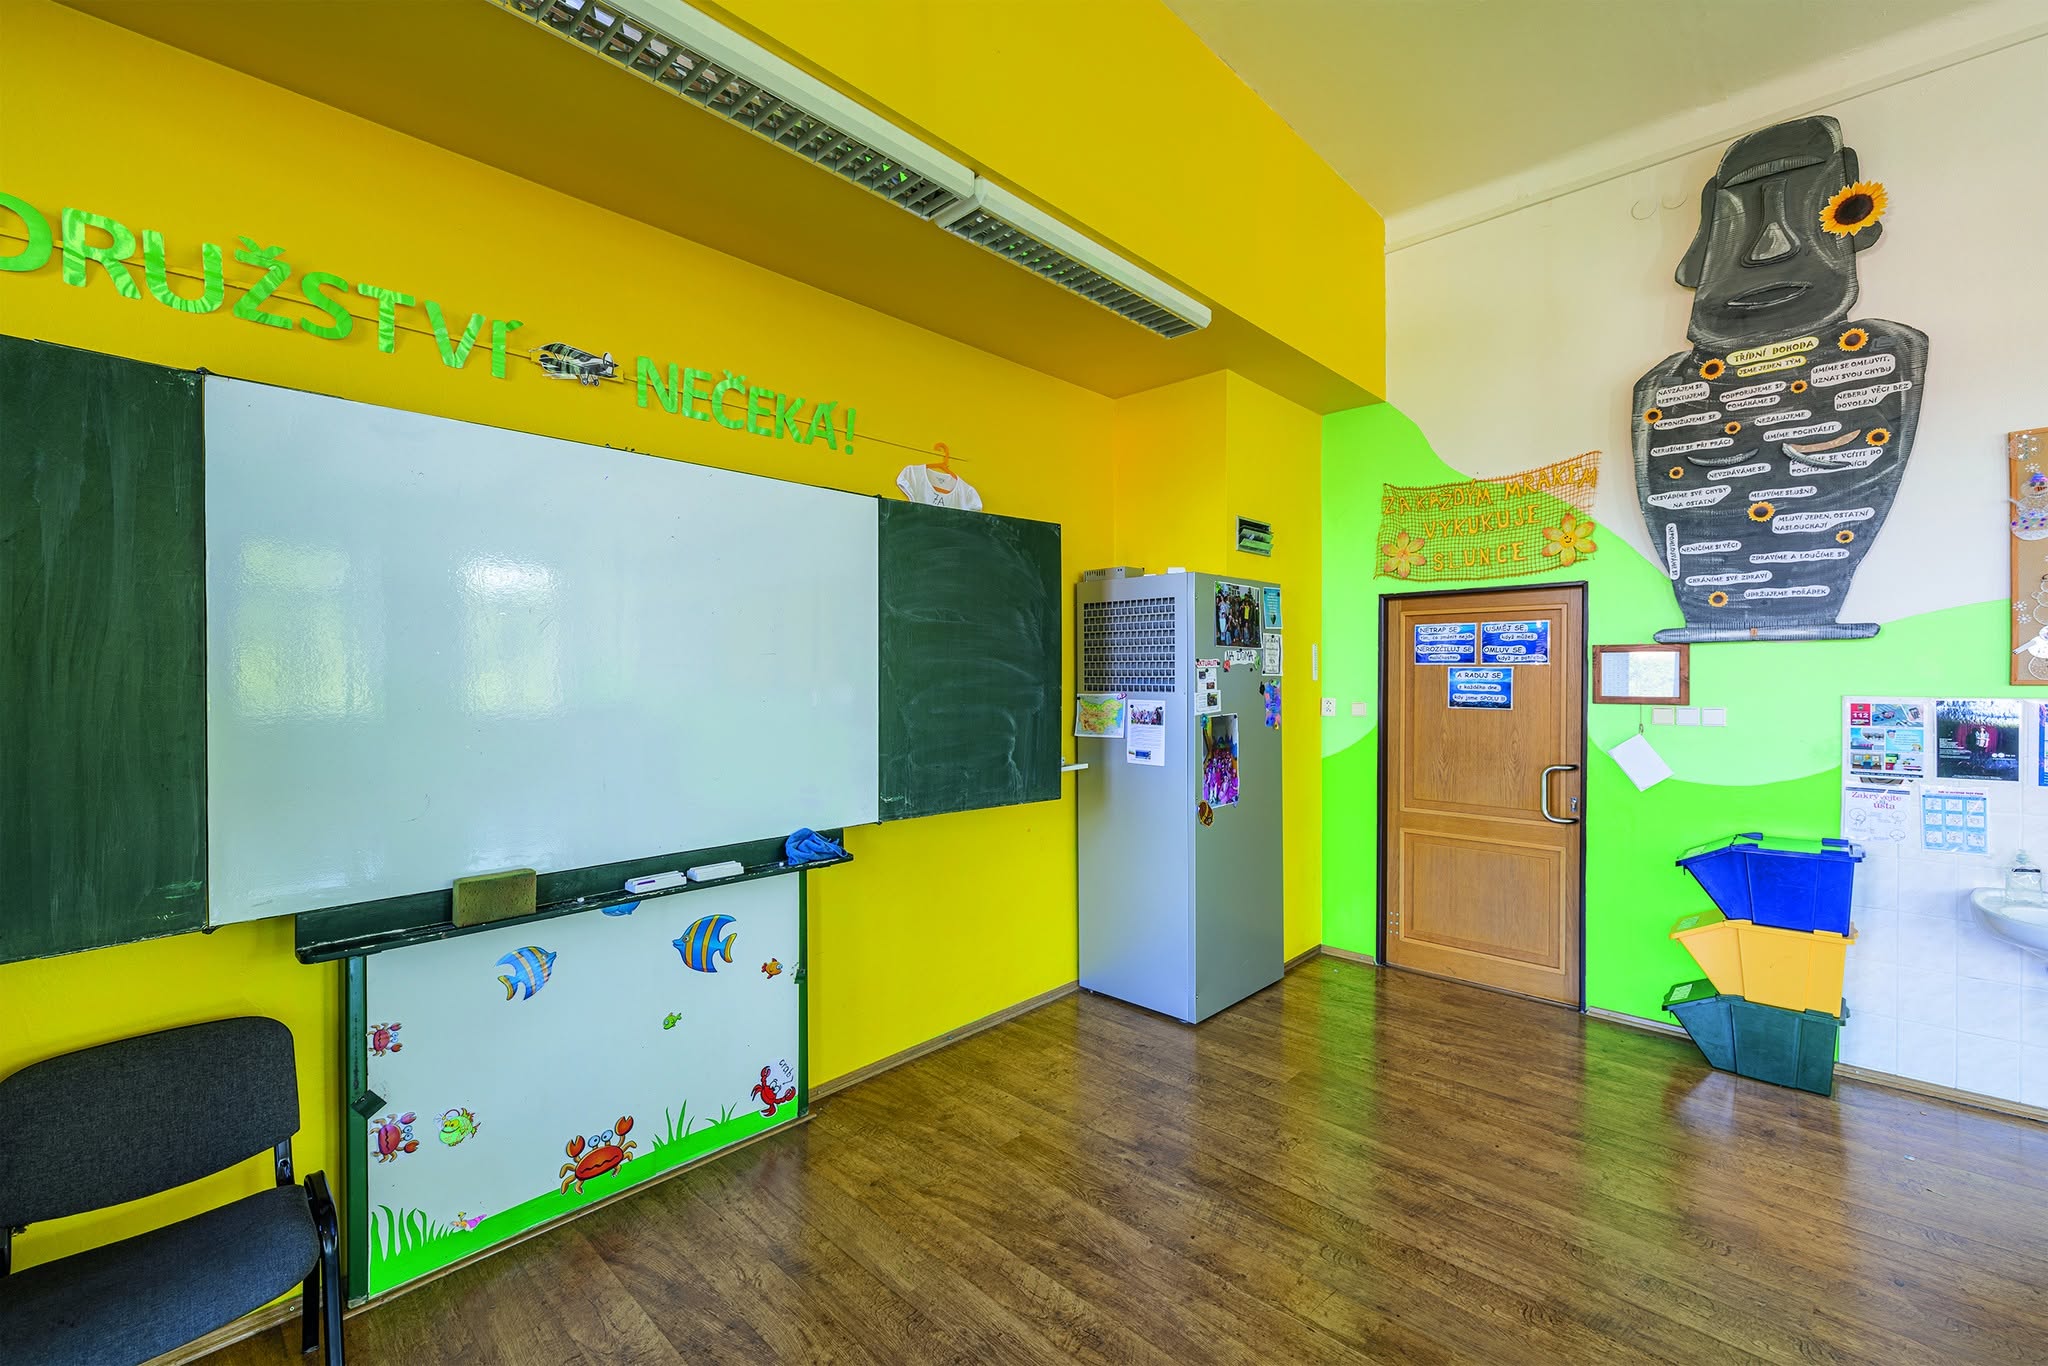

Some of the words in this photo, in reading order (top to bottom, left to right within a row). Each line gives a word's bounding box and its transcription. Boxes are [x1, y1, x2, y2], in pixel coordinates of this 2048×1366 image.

[1734, 349, 1767, 363] TŘÍDNÍ
[1772, 340, 1814, 356] DOHODA
[1738, 365, 1758, 376] JSME
[1758, 362, 1782, 373] JEDEN
[1784, 356, 1801, 367] TÝM
[1812, 363, 1839, 374] UMÍME
[1840, 361, 1850, 370] SE
[1812, 373, 1840, 385] UZNAT
[1841, 370, 1863, 381] SVOU
[1864, 366, 1892, 378] CHYBU
[1695, 382, 1703, 390] SE
[1721, 385, 1772, 400] PODPORUJEME
[1836, 389, 1868, 400] NEBERU
[1870, 385, 1890, 395] VĚCI
[1893, 382, 1910, 392] BEZ
[637, 356, 857, 455] NEČEKÁ!
[1836, 397, 1879, 410] DOVOLENÍ
[1764, 430, 1790, 440] UMÍME
[1870, 448, 1881, 456] DO
[1757, 464, 1767, 472] SE
[1383, 495, 1412, 515] ZA
[1416, 478, 1494, 512] KAŽDÝM
[1504, 463, 1598, 500] MRAKEM
[1750, 490, 1784, 499] MLUVÍME
[1785, 486, 1815, 496] SLUŠNĚ
[1673, 501, 1683, 509] NA
[1685, 498, 1717, 507] OSTATNÍ
[1424, 504, 1542, 539] VYKUKUJE
[1778, 514, 1803, 523] MLUVÍ
[1804, 513, 1832, 521] JEDEN,
[1833, 509, 1870, 519] OSTATNÍ
[1774, 522, 1829, 532] NASLOUCHAJÍ
[1680, 543, 1714, 553] NENIČÍME
[1433, 541, 1527, 571] SLUNCE
[1751, 553, 1788, 562] ZDRAVÍME
[1687, 574, 1723, 584] CHRÁNÍME
[1741, 572, 1769, 581] ZDRAVÍ
[1745, 589, 1789, 598] UDRŽUJEME
[1791, 587, 1827, 597] POŘÁDEK
[1483, 646, 1510, 654] OMLUV
[779, 1059, 794, 1078] crab
